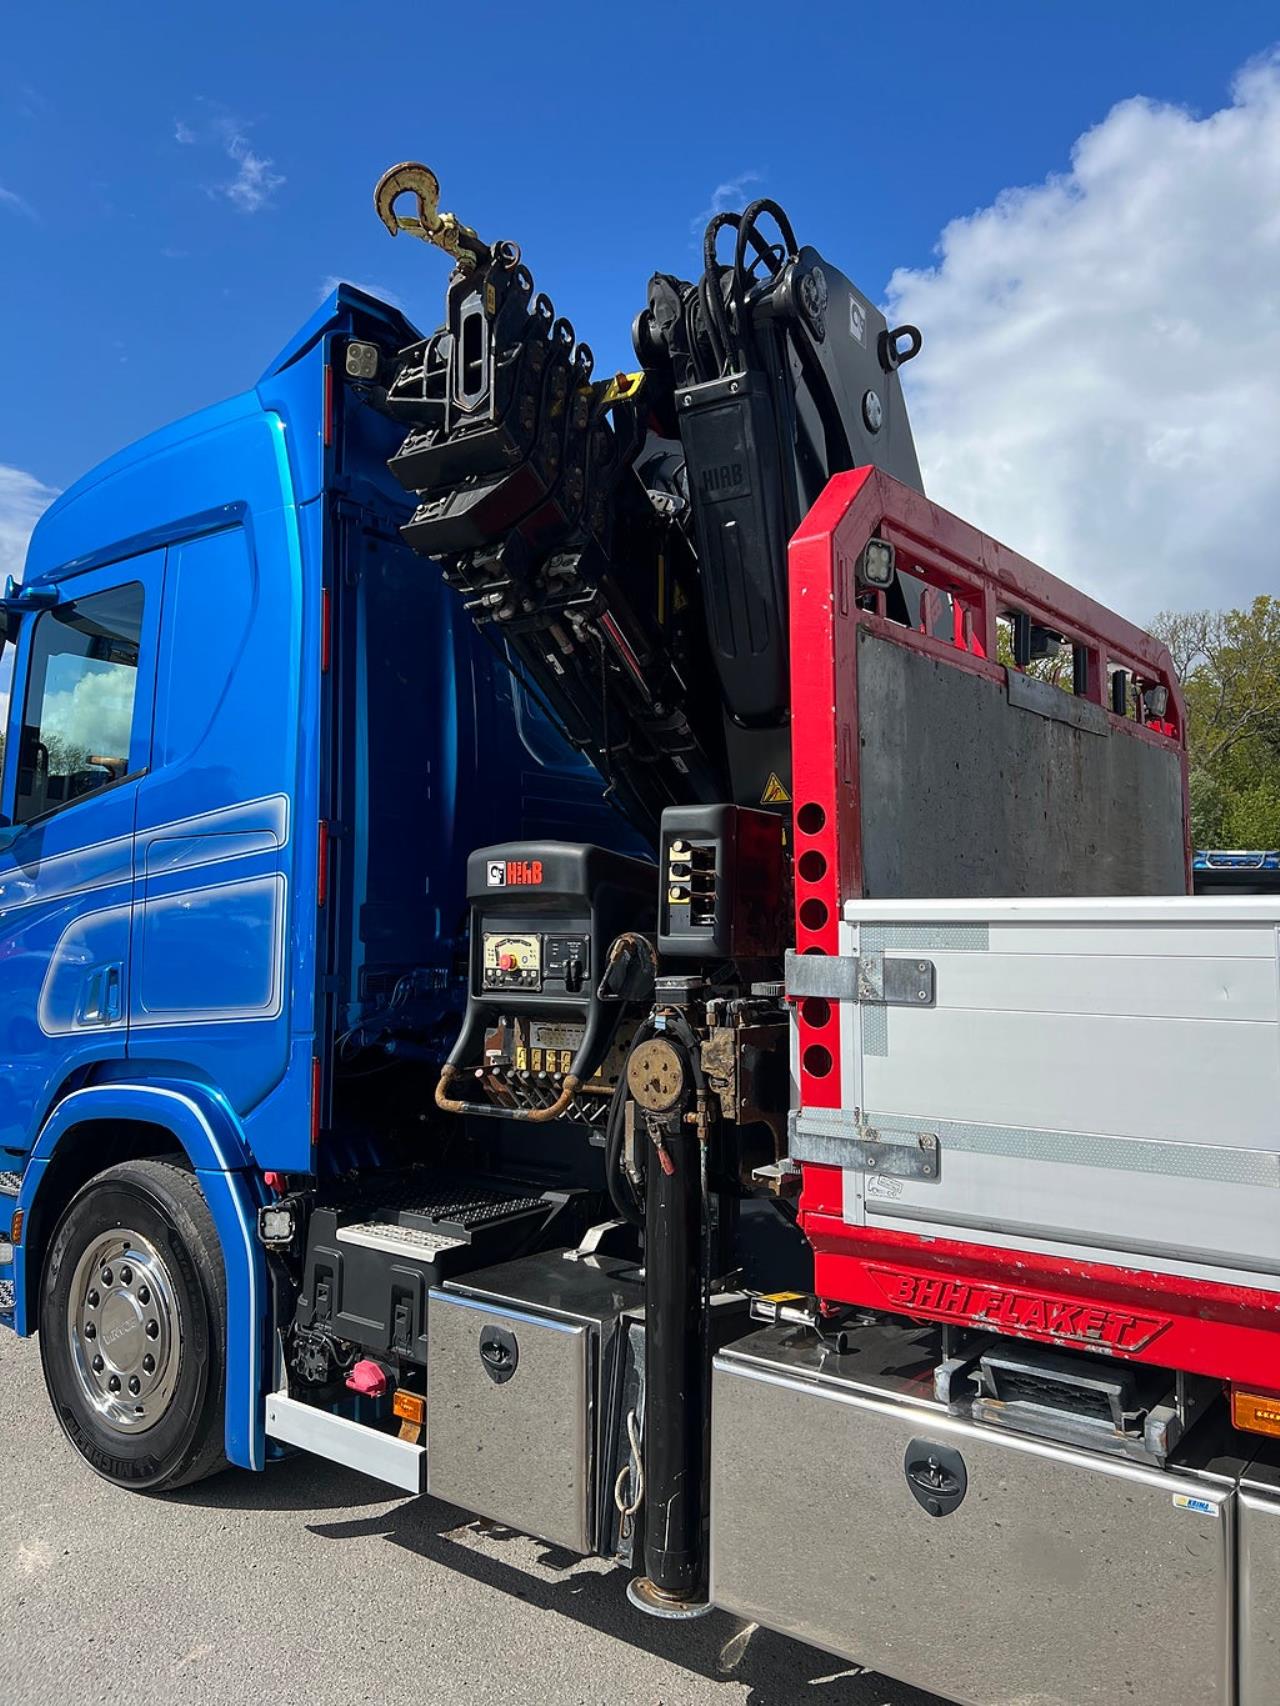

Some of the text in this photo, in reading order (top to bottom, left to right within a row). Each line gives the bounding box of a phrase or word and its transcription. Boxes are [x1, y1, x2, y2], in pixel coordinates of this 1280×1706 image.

[703, 465, 742, 490] HIAB
[507, 861, 542, 885] HIAB
[896, 1277, 1136, 1343] BHH FLAKET
